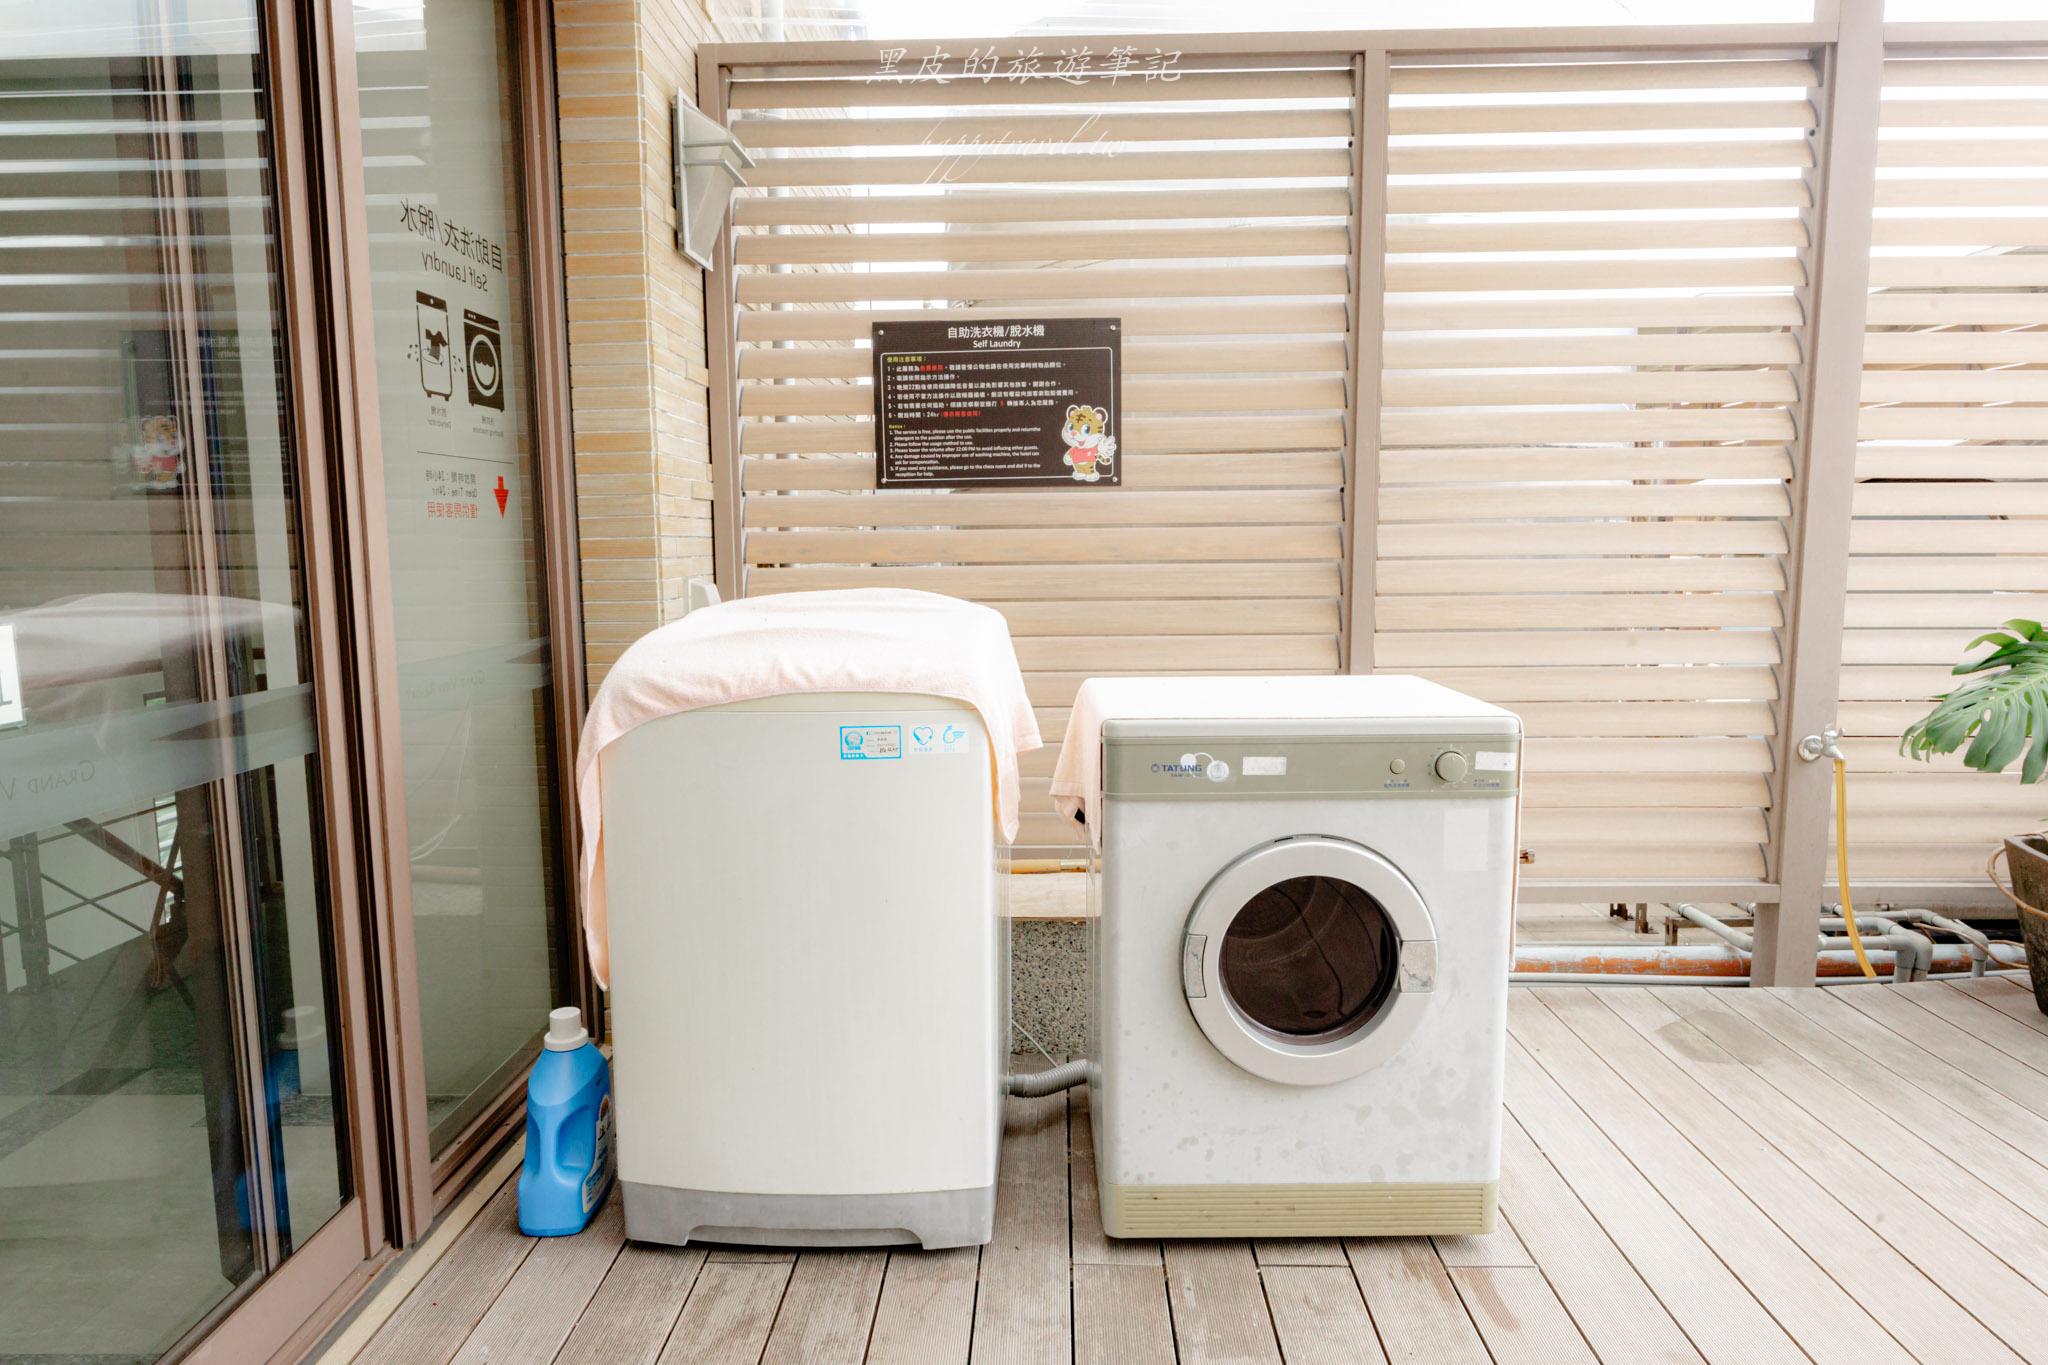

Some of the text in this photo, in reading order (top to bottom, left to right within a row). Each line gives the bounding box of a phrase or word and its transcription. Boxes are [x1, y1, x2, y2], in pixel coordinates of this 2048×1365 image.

[948, 325, 1045, 338] 自助洗衣機/脫水機
[973, 339, 1021, 349] Self Laundry
[1162, 764, 1202, 772] TATUNG
